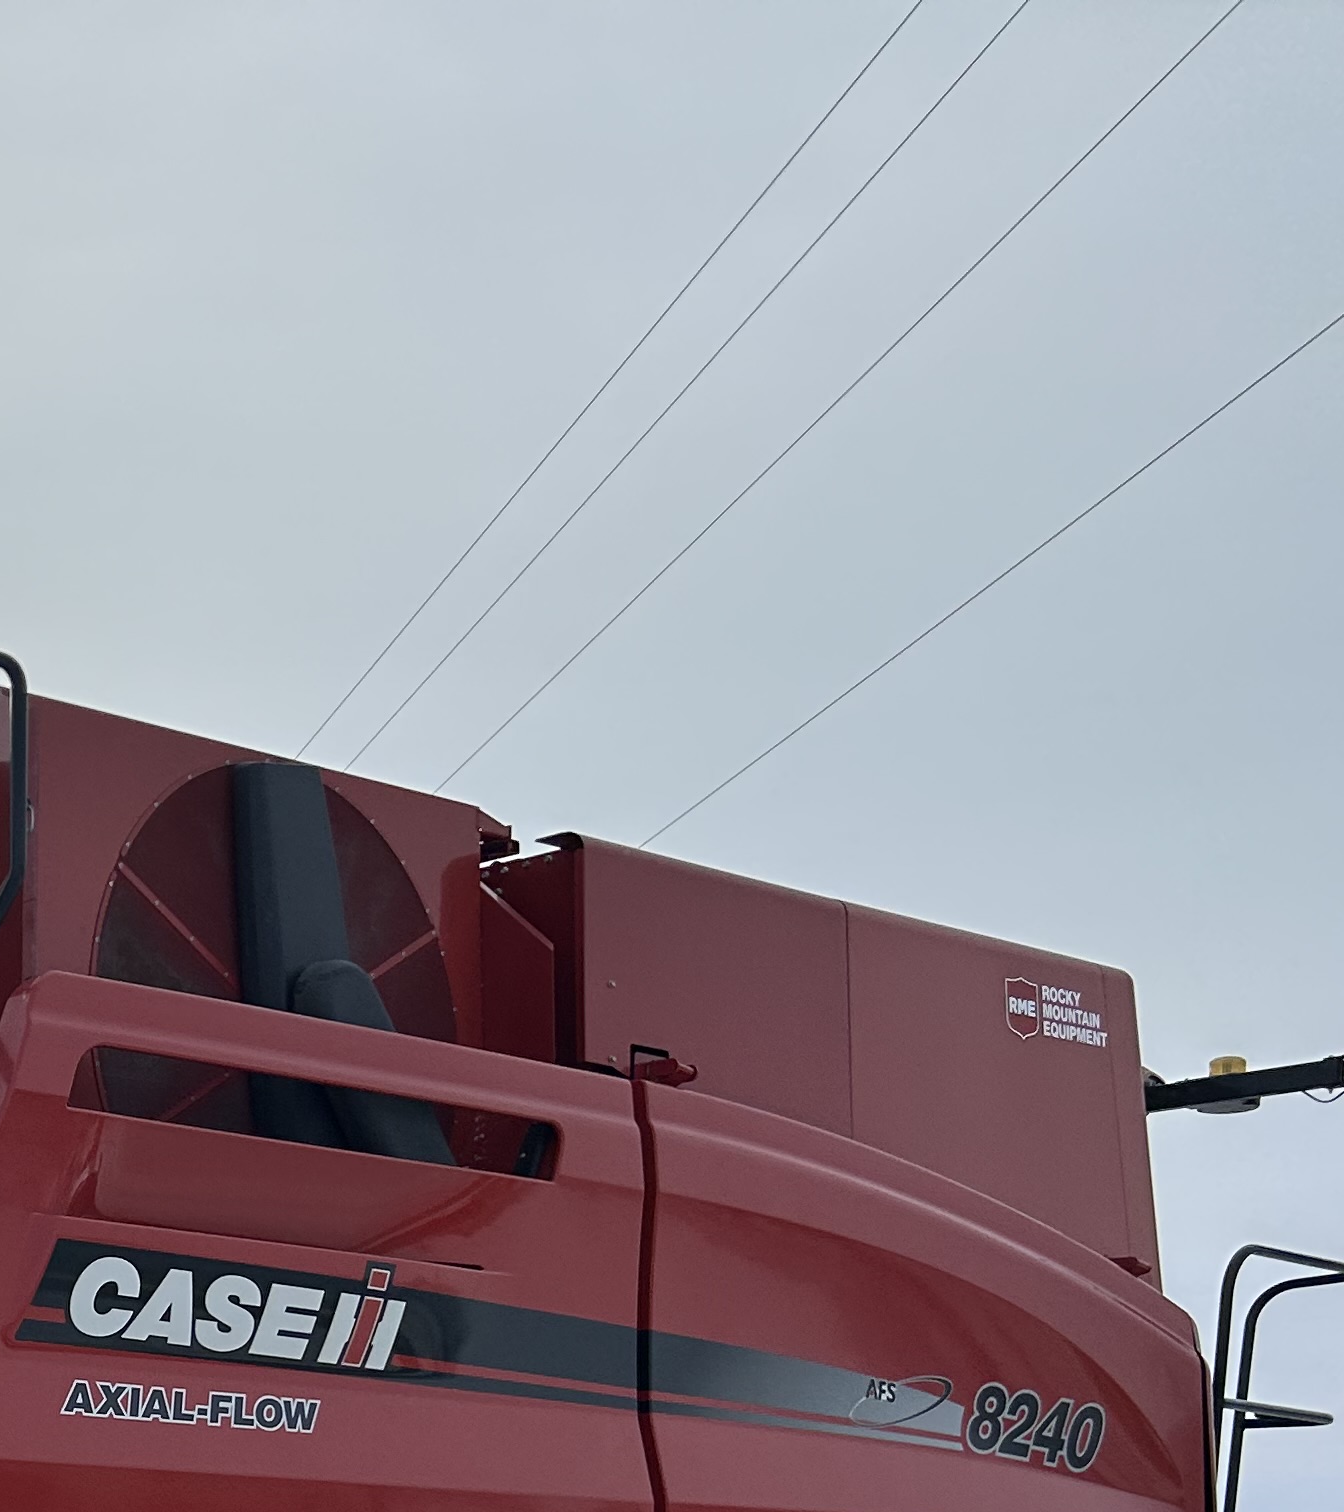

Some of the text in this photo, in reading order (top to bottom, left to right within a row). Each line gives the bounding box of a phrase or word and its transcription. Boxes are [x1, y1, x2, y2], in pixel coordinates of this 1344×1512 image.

[1009, 997, 1036, 1017] RME
[1042, 985, 1081, 1007] ROCKY
[1042, 1003, 1100, 1028] MOUNTAIN
[1043, 1021, 1108, 1047] EQUIPMENT
[866, 1379, 896, 1402] AFS
[60, 1380, 321, 1433] AXIAL-FLOW
[967, 1381, 1105, 1473] 8240
